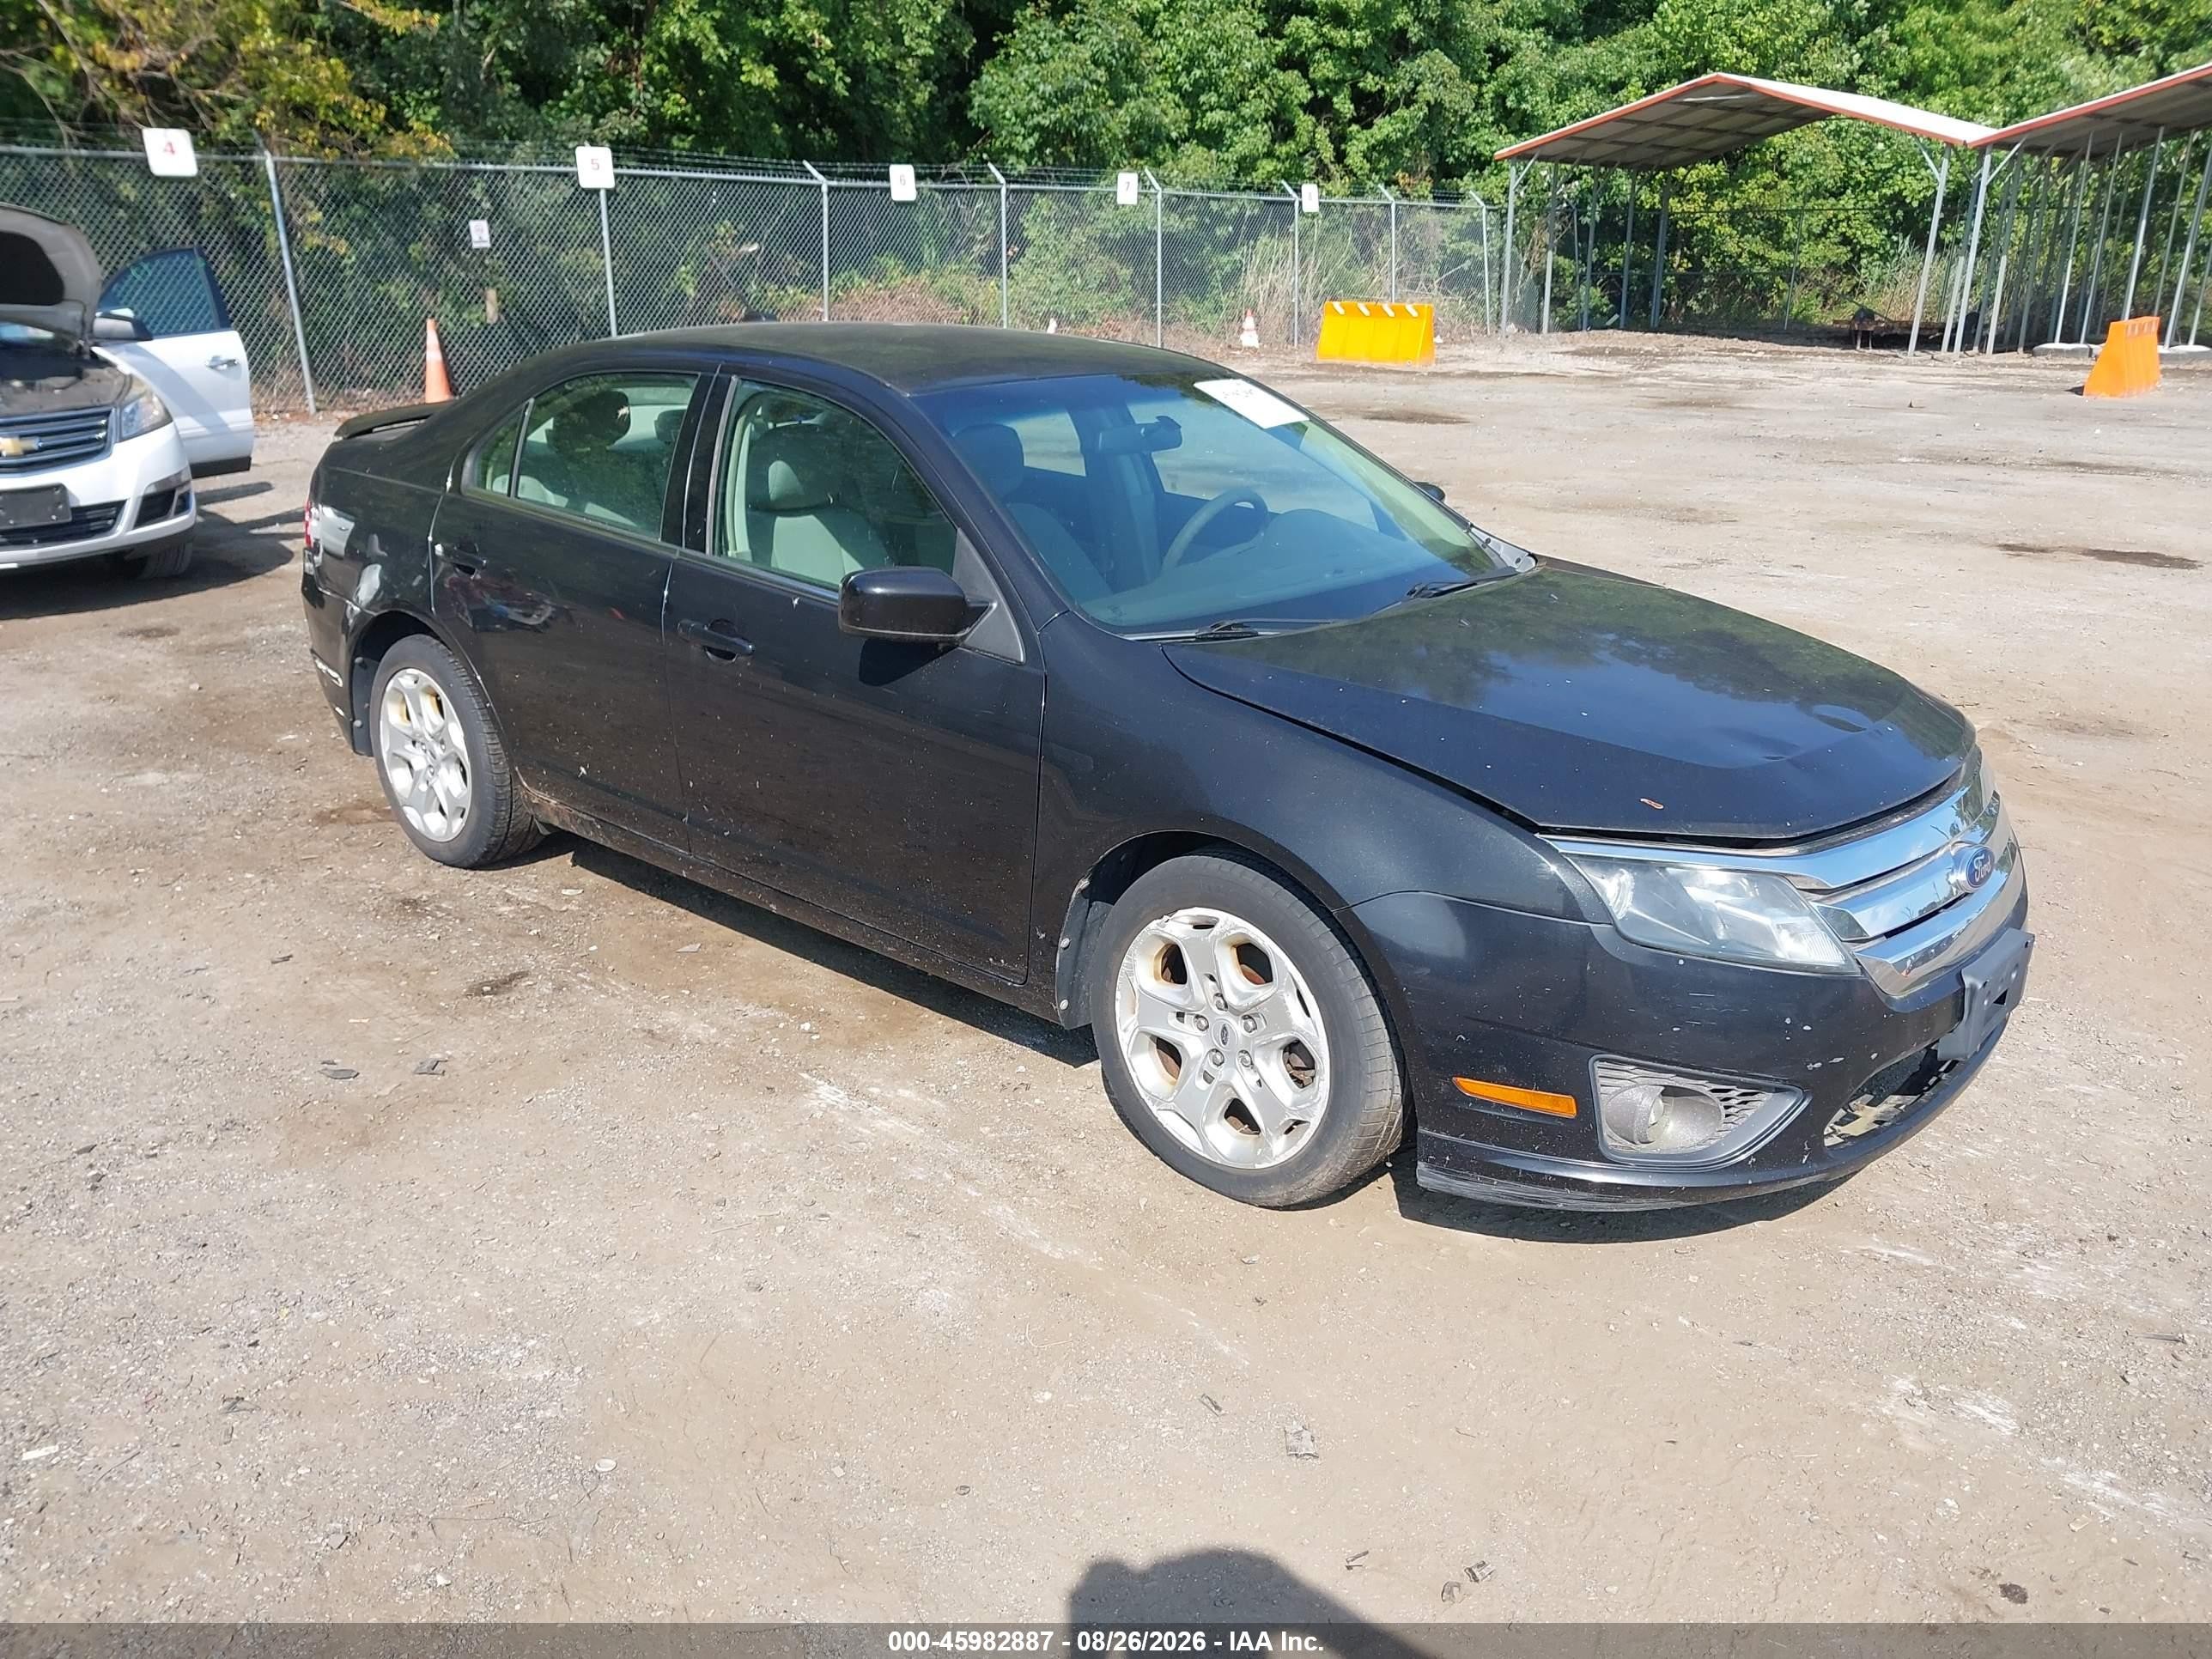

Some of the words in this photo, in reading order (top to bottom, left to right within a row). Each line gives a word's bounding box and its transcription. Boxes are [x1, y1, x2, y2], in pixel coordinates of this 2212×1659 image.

[163, 142, 175, 155] 4
[590, 158, 600, 171] 5
[899, 173, 907, 186] 6
[1124, 180, 1131, 191] 7
[1973, 853, 1992, 883] Ford
